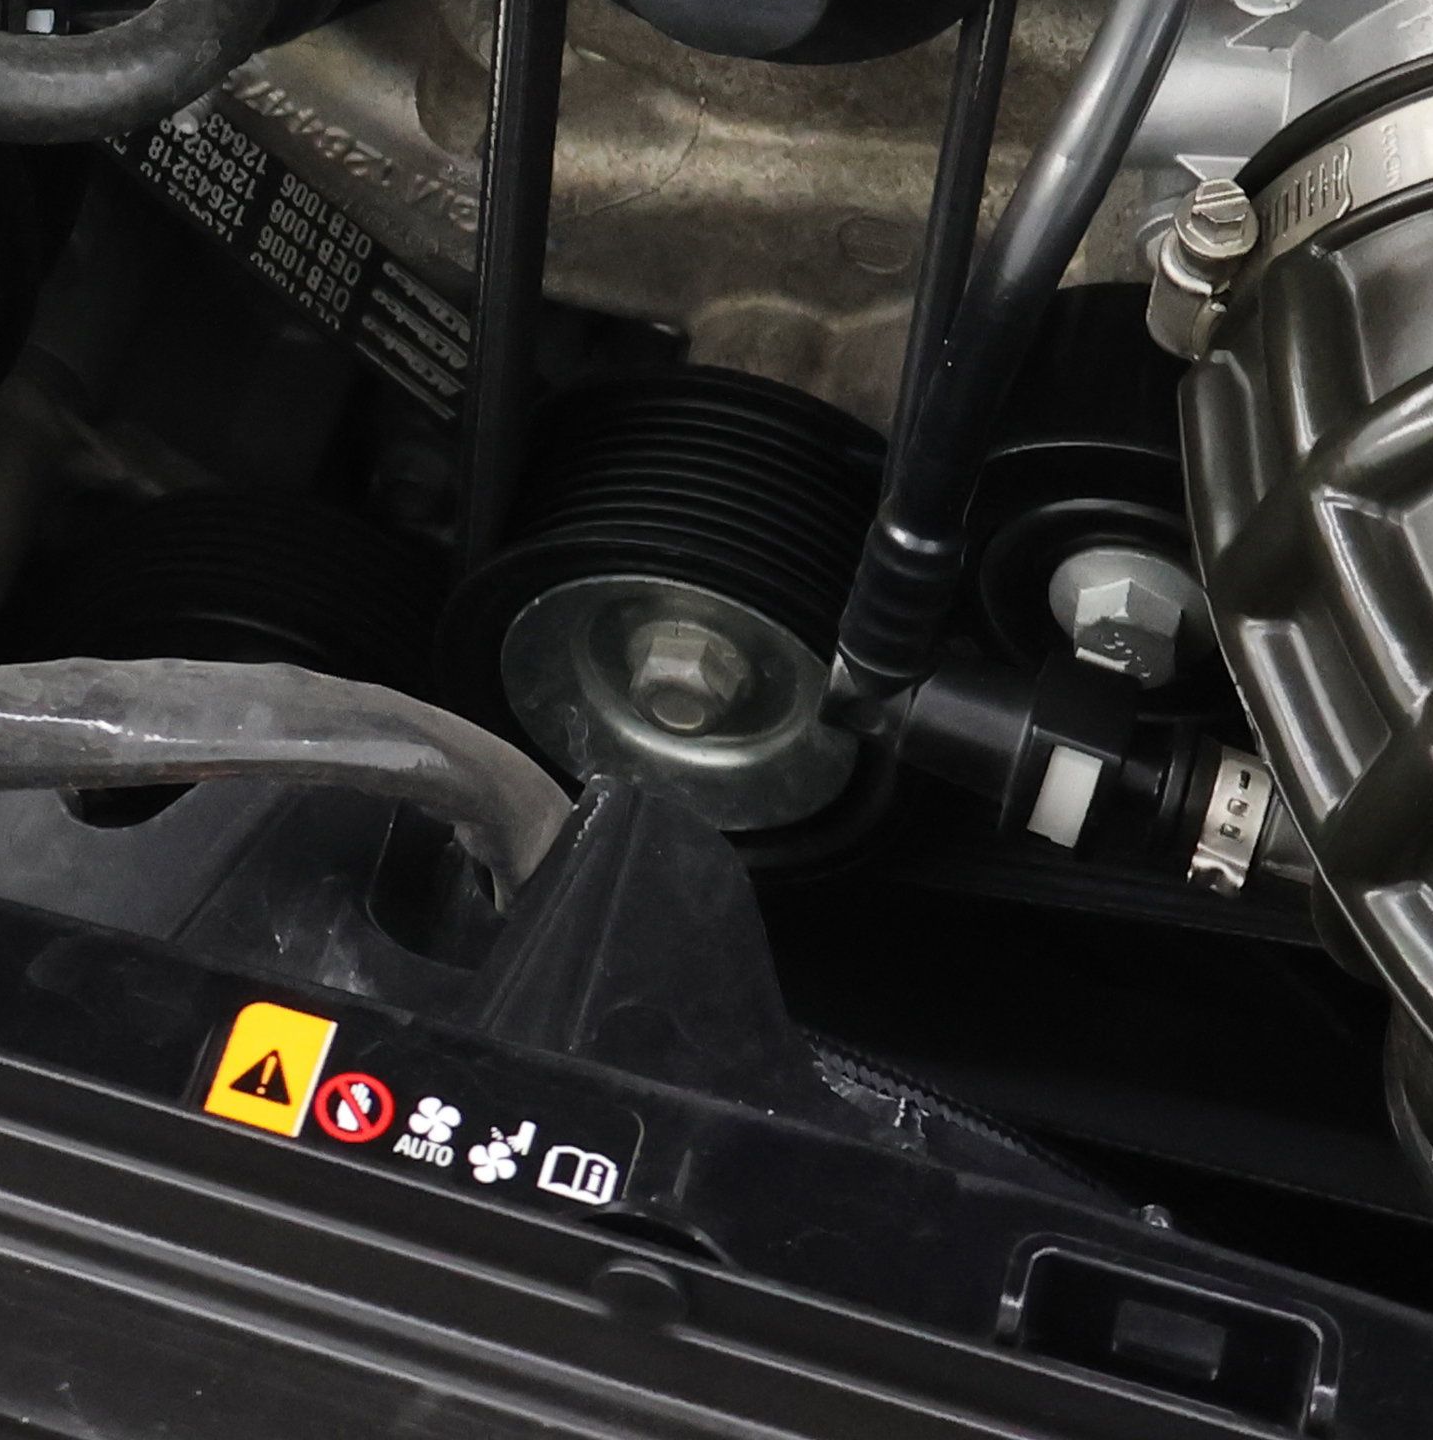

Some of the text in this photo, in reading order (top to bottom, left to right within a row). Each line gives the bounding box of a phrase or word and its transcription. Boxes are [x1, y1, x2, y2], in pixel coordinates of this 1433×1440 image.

[201, 113, 268, 176] 12643
[148, 135, 245, 227] 12643218
[393, 1134, 455, 1168] AUTO
